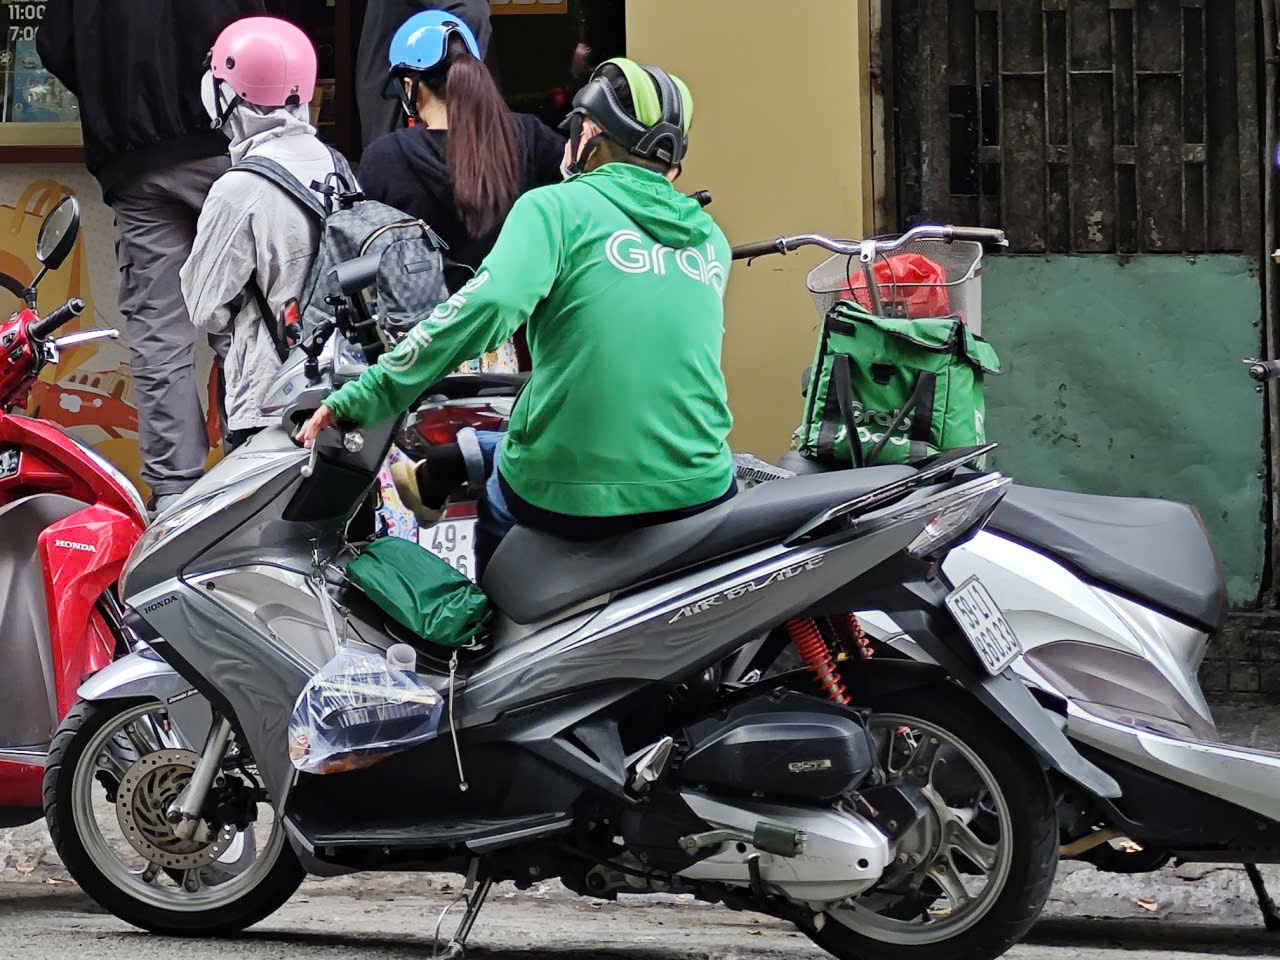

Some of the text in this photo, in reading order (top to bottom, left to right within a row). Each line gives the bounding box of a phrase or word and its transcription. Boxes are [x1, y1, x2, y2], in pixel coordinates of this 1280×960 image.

[54, 539, 98, 553] HONDA
[144, 595, 179, 614] HONDA
[668, 554, 825, 624] AIR BLADE
[953, 584, 993, 630] 59-L1
